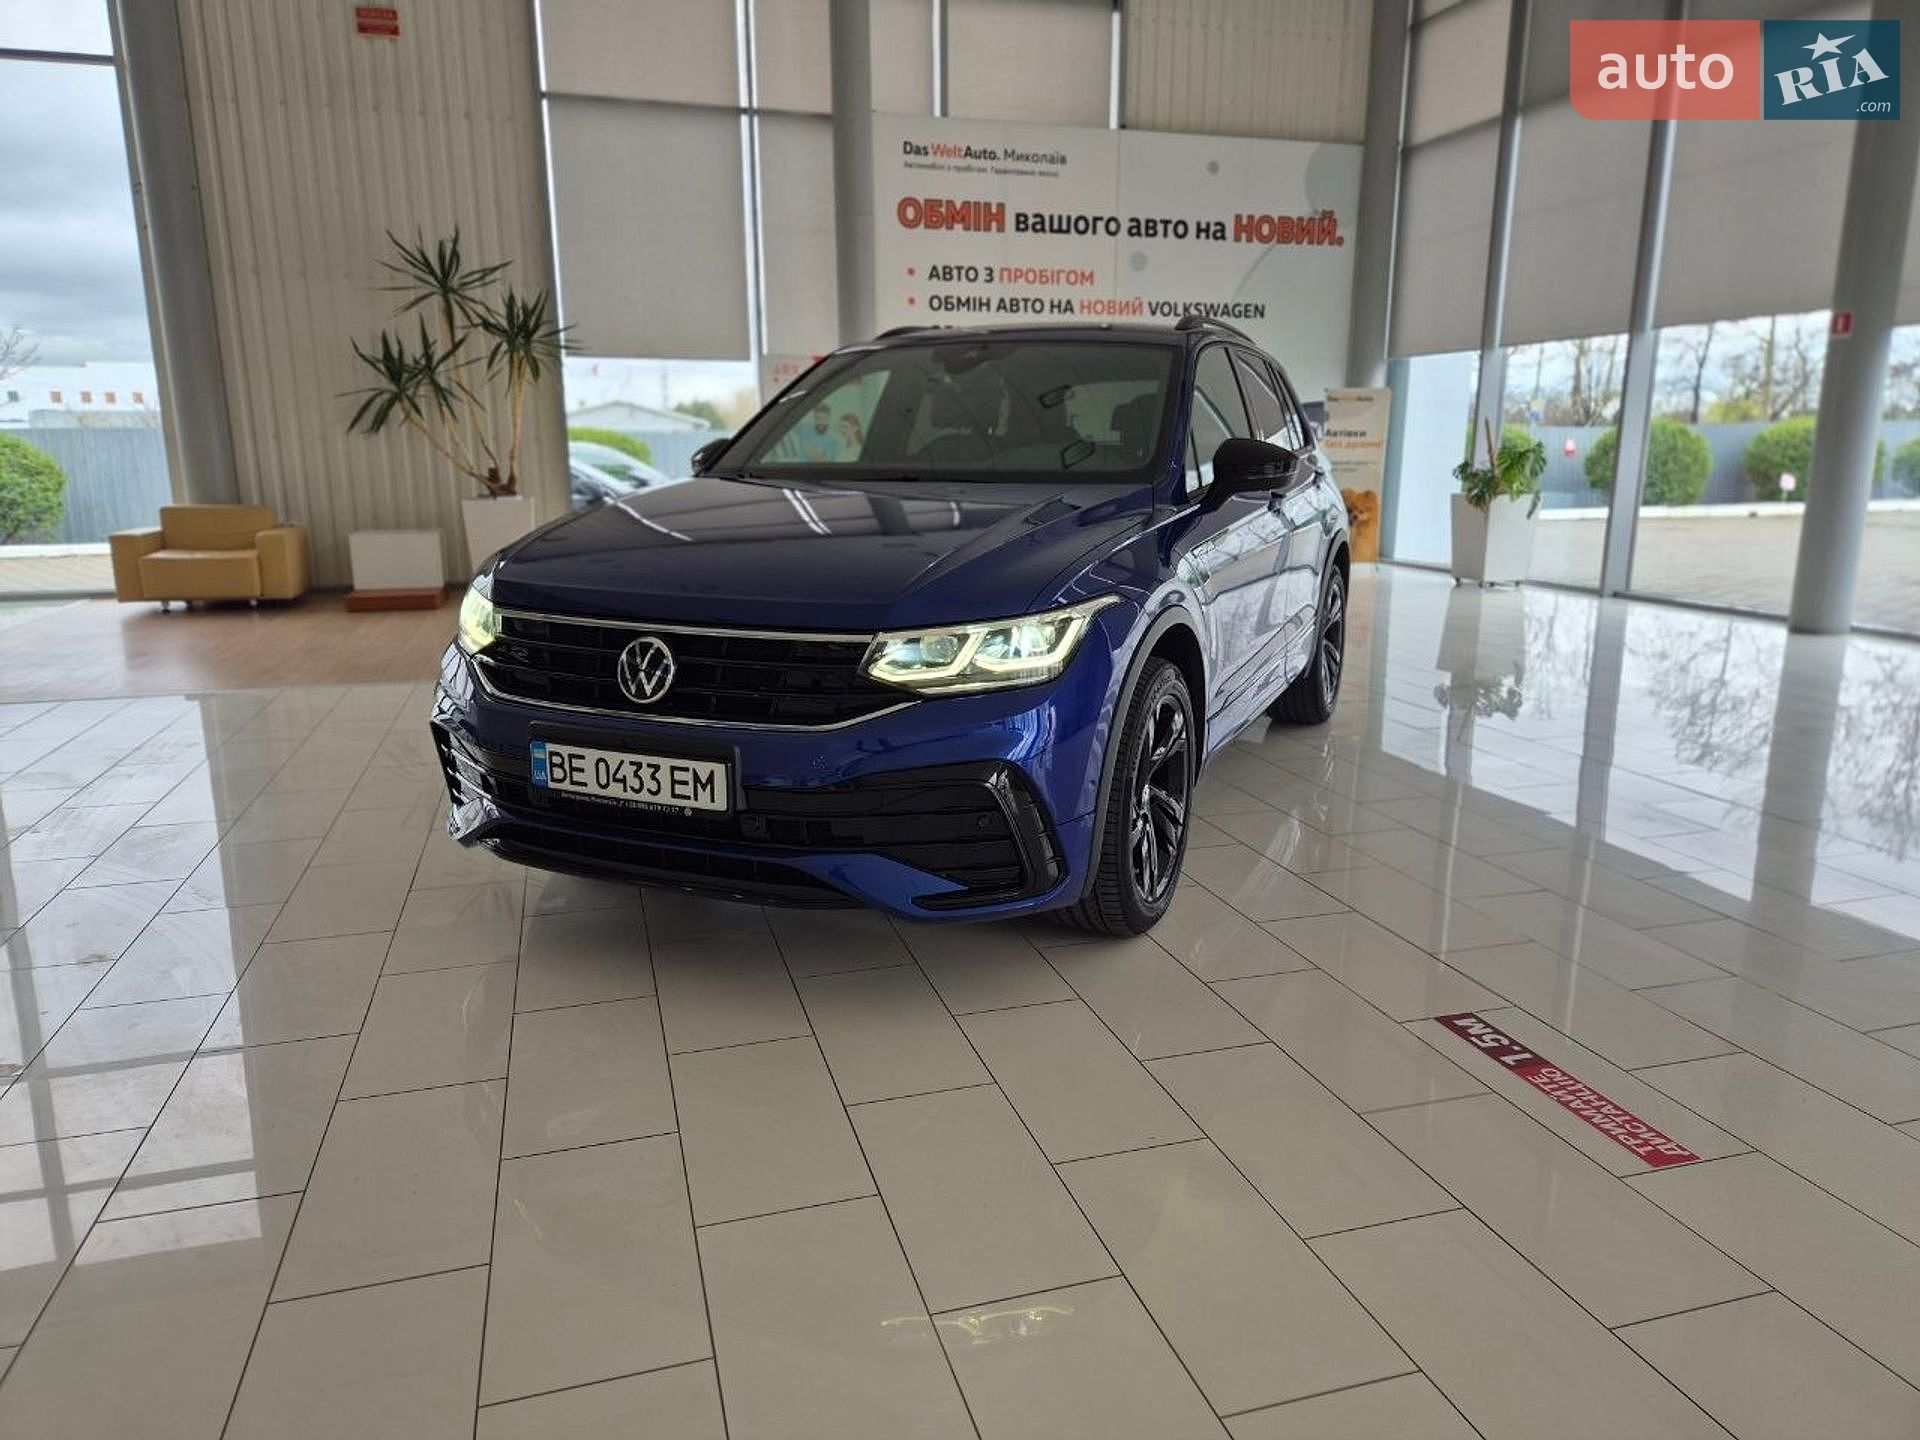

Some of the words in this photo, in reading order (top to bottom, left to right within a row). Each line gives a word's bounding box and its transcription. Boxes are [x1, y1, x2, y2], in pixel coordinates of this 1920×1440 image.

[1003, 148, 1067, 166] Миколаїв
[897, 196, 1006, 234] ОБМІН
[1015, 212, 1121, 237] вашого
[1127, 216, 1189, 240] авто
[1195, 219, 1227, 241] на
[1232, 209, 1345, 247] НОВИЙ.
[928, 264, 979, 283] АВТО
[999, 266, 1096, 286] ПРОБІГОМ
[929, 294, 991, 313] ОБМІН
[996, 297, 1045, 315] АВТО
[1050, 299, 1075, 315] НА
[1080, 297, 1144, 317] НОВИЙ
[1148, 301, 1266, 320] VOLKSWAGEN
[549, 751, 588, 788] BE
[594, 757, 662, 796] 0433
[669, 764, 716, 804] EM
